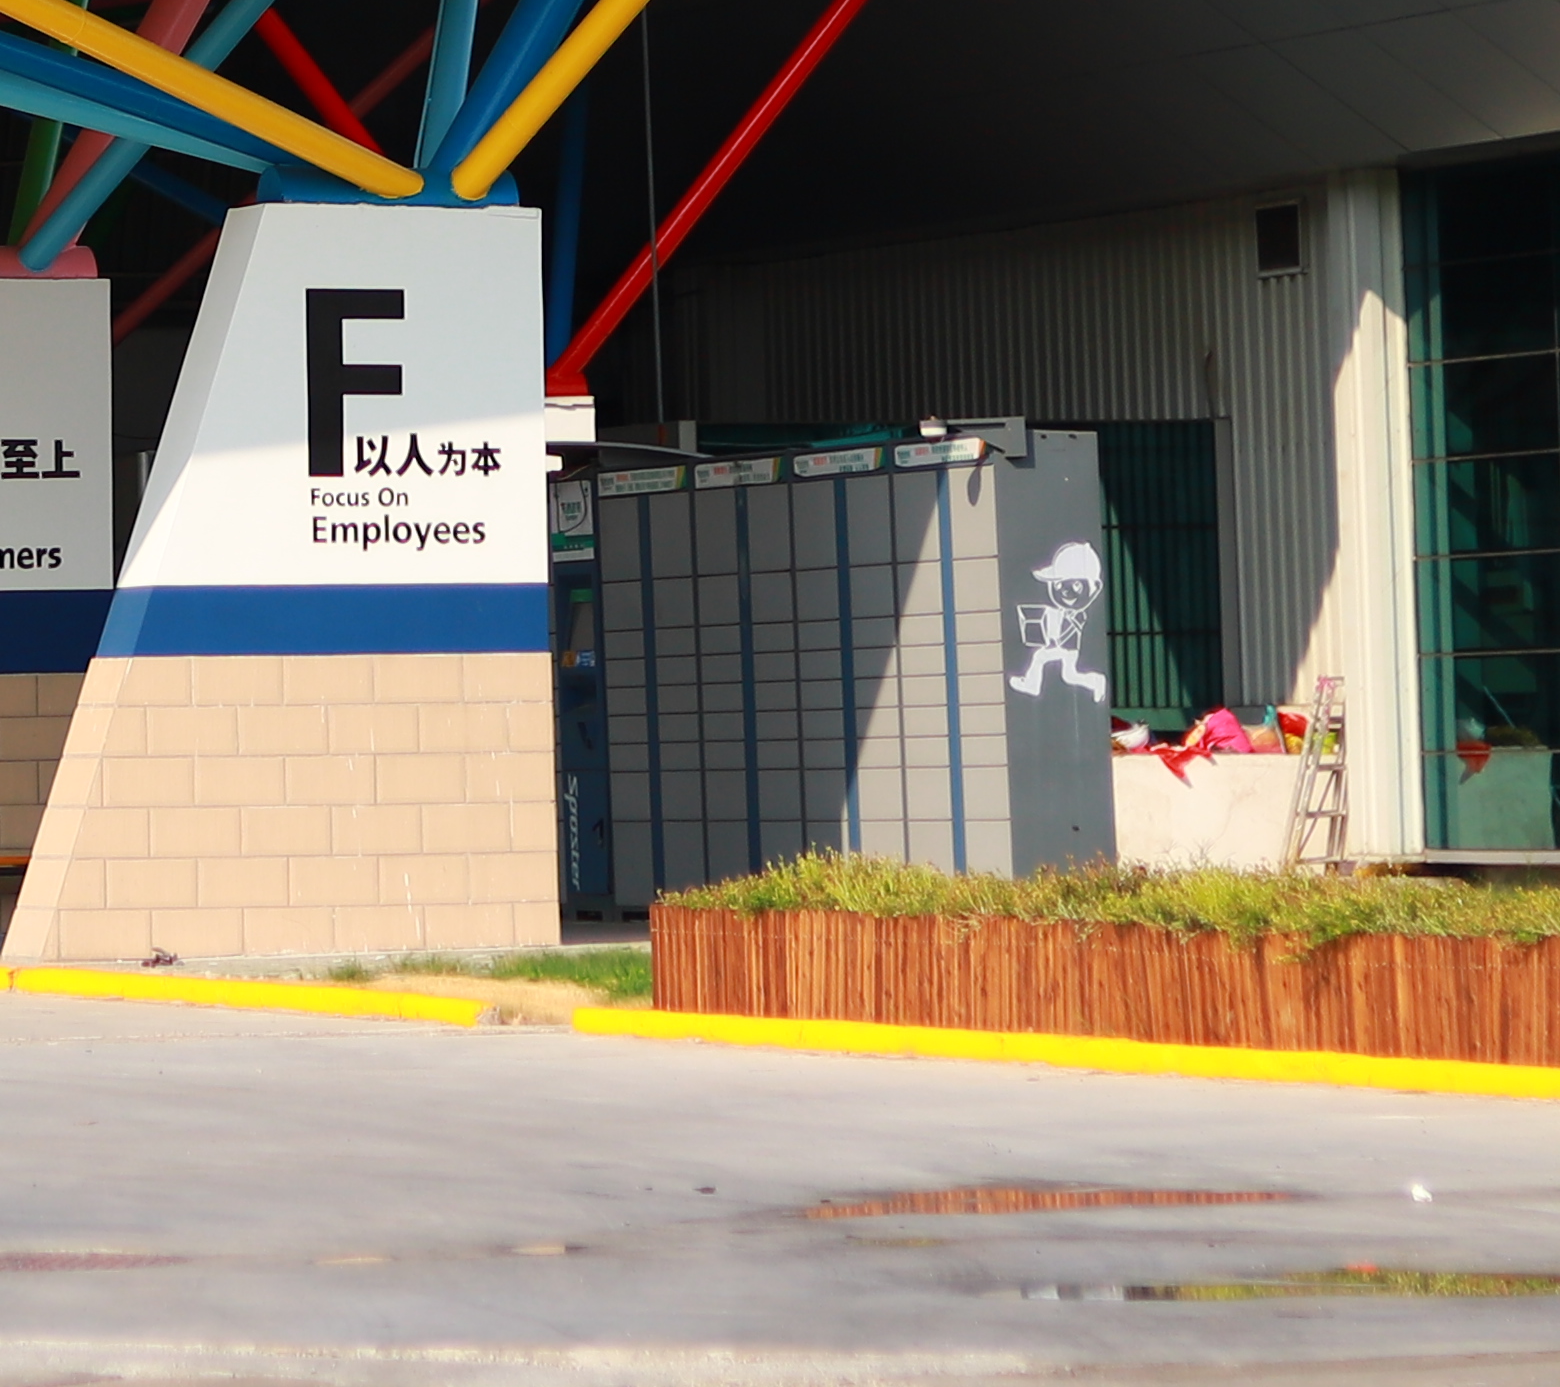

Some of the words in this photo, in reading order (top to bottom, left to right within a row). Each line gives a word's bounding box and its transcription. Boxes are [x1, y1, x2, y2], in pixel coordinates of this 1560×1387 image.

[306, 288, 405, 477] F
[354, 432, 502, 477] 以人为本
[310, 487, 370, 507] Focus
[378, 487, 409, 507] On
[312, 514, 486, 551] Employees
[563, 772, 581, 892] Sposter
